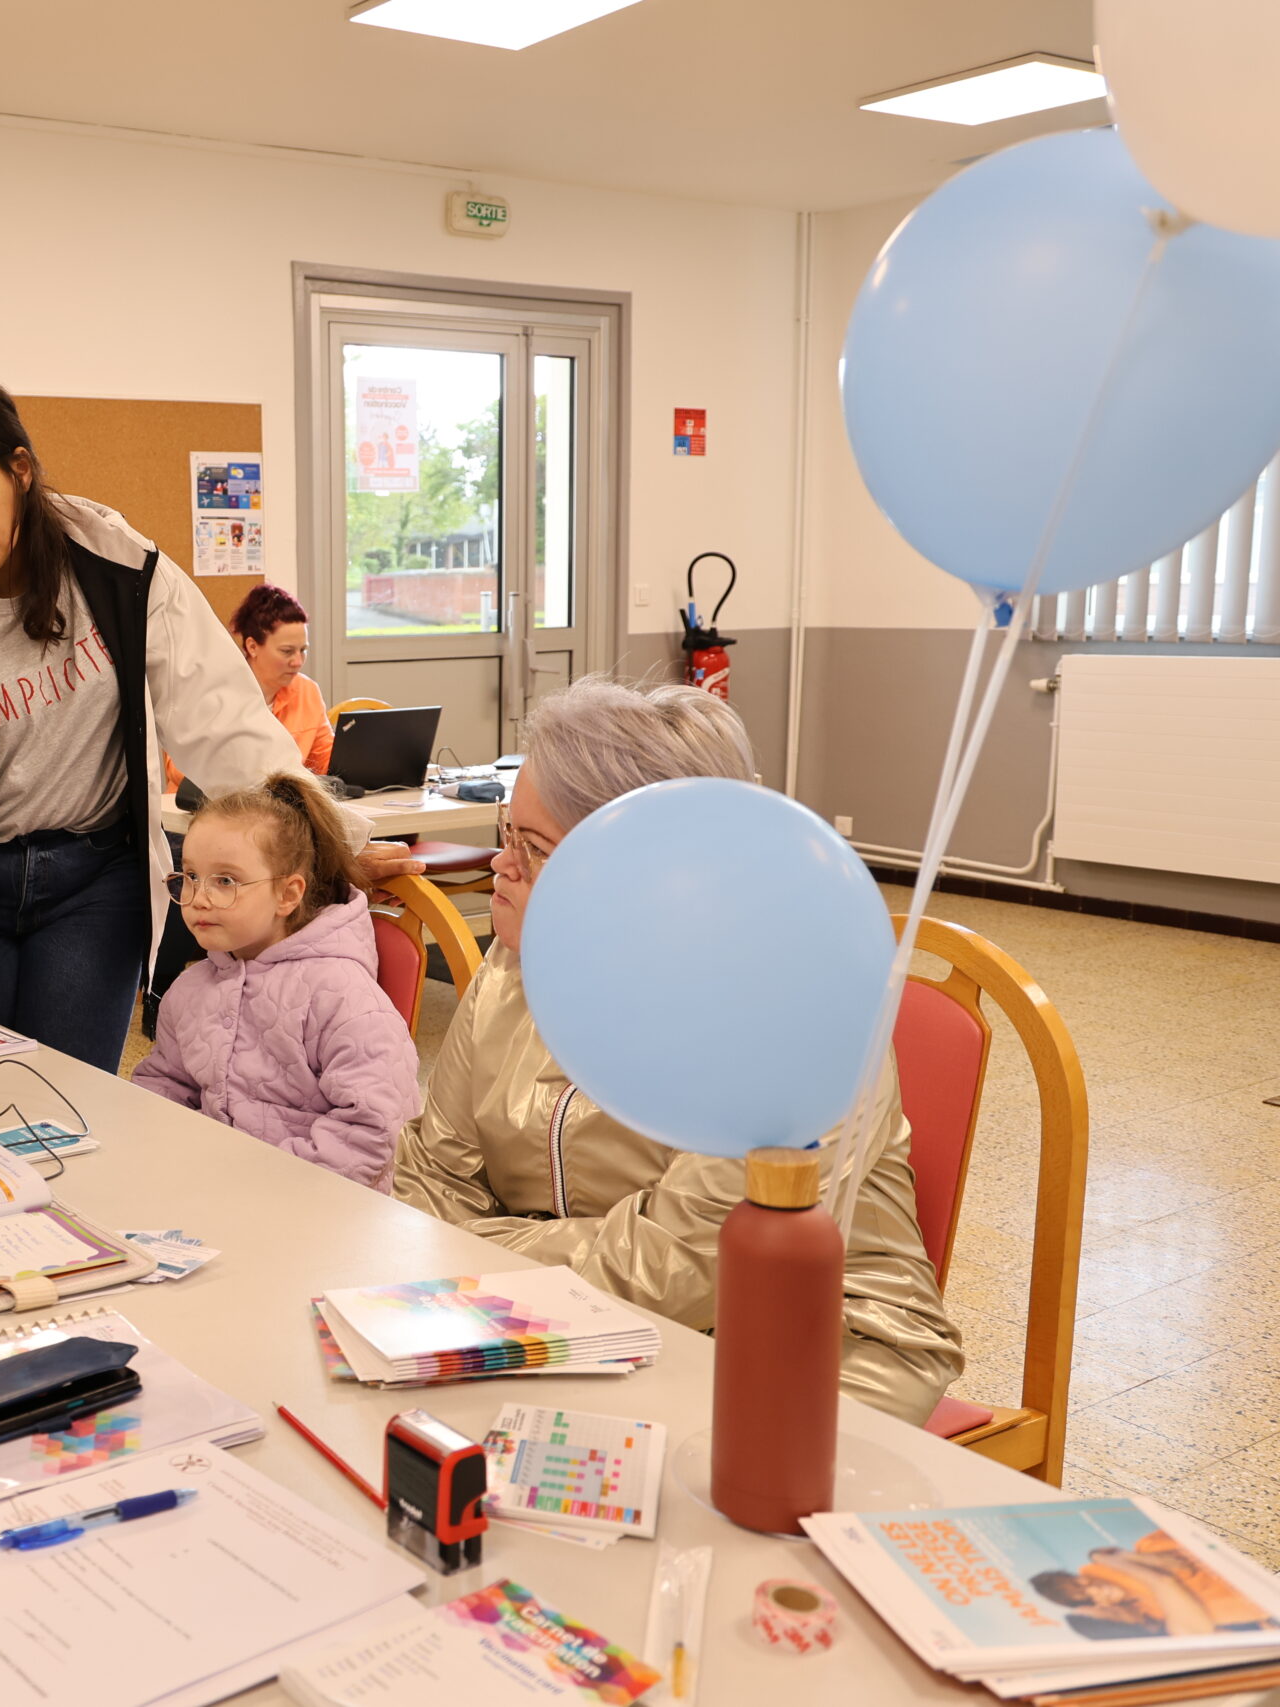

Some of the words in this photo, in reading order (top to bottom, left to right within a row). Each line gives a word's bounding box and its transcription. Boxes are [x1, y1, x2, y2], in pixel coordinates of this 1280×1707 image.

[467, 202, 506, 220] SORTIE
[879, 1521, 919, 1549] LES
[904, 1552, 943, 1574] NE
[929, 1577, 972, 1606] ON
[974, 1566, 1062, 1627] JAMAIS
[502, 1612, 602, 1679] vaccination
[520, 1605, 584, 1647] Carnet
[581, 1645, 608, 1665] de
